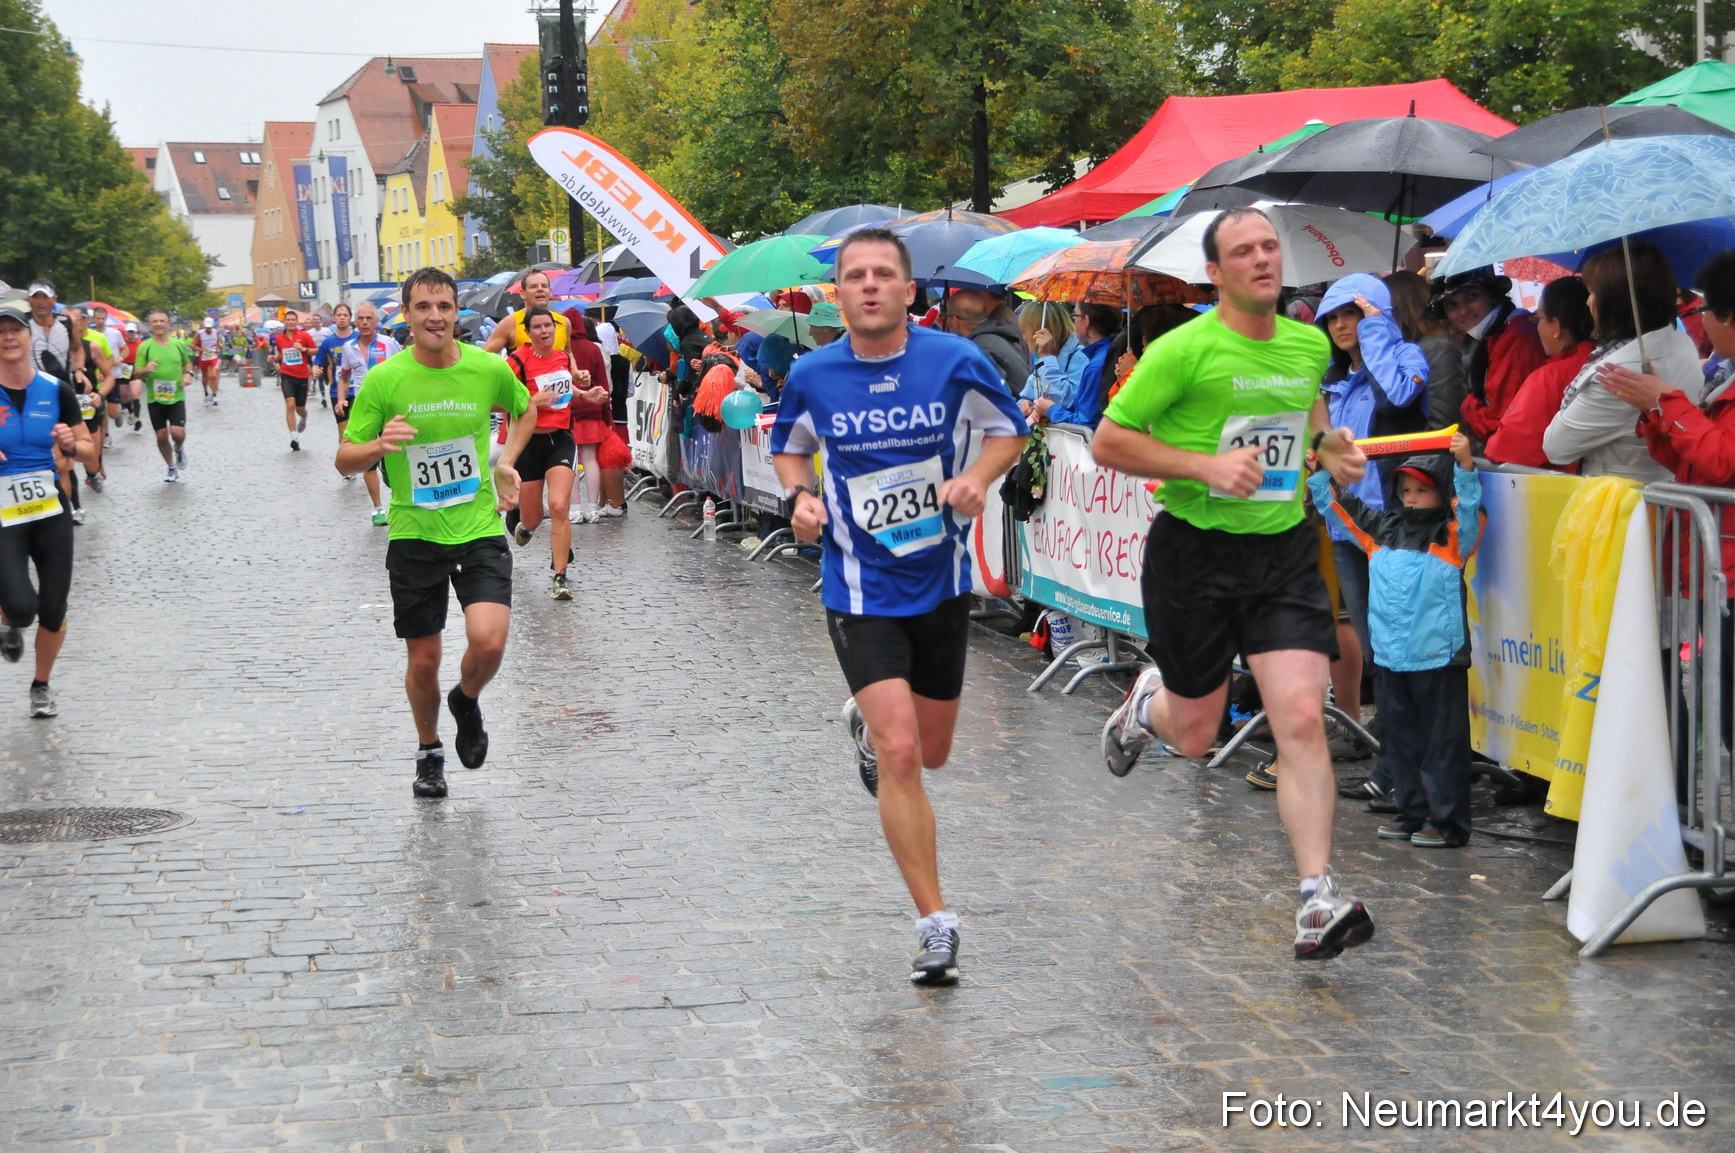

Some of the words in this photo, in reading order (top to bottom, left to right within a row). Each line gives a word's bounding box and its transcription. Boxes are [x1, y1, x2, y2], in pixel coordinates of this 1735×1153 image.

[1302, 224, 1345, 267] Oberbank
[869, 382, 896, 394] PUMA
[831, 401, 947, 437] SYSCAD
[417, 453, 473, 486] 3113
[8, 480, 46, 503] 155
[433, 485, 462, 500] Daniel
[17, 505, 44, 516] Sabine
[863, 482, 940, 531] 2234
[891, 527, 922, 544] Marc
